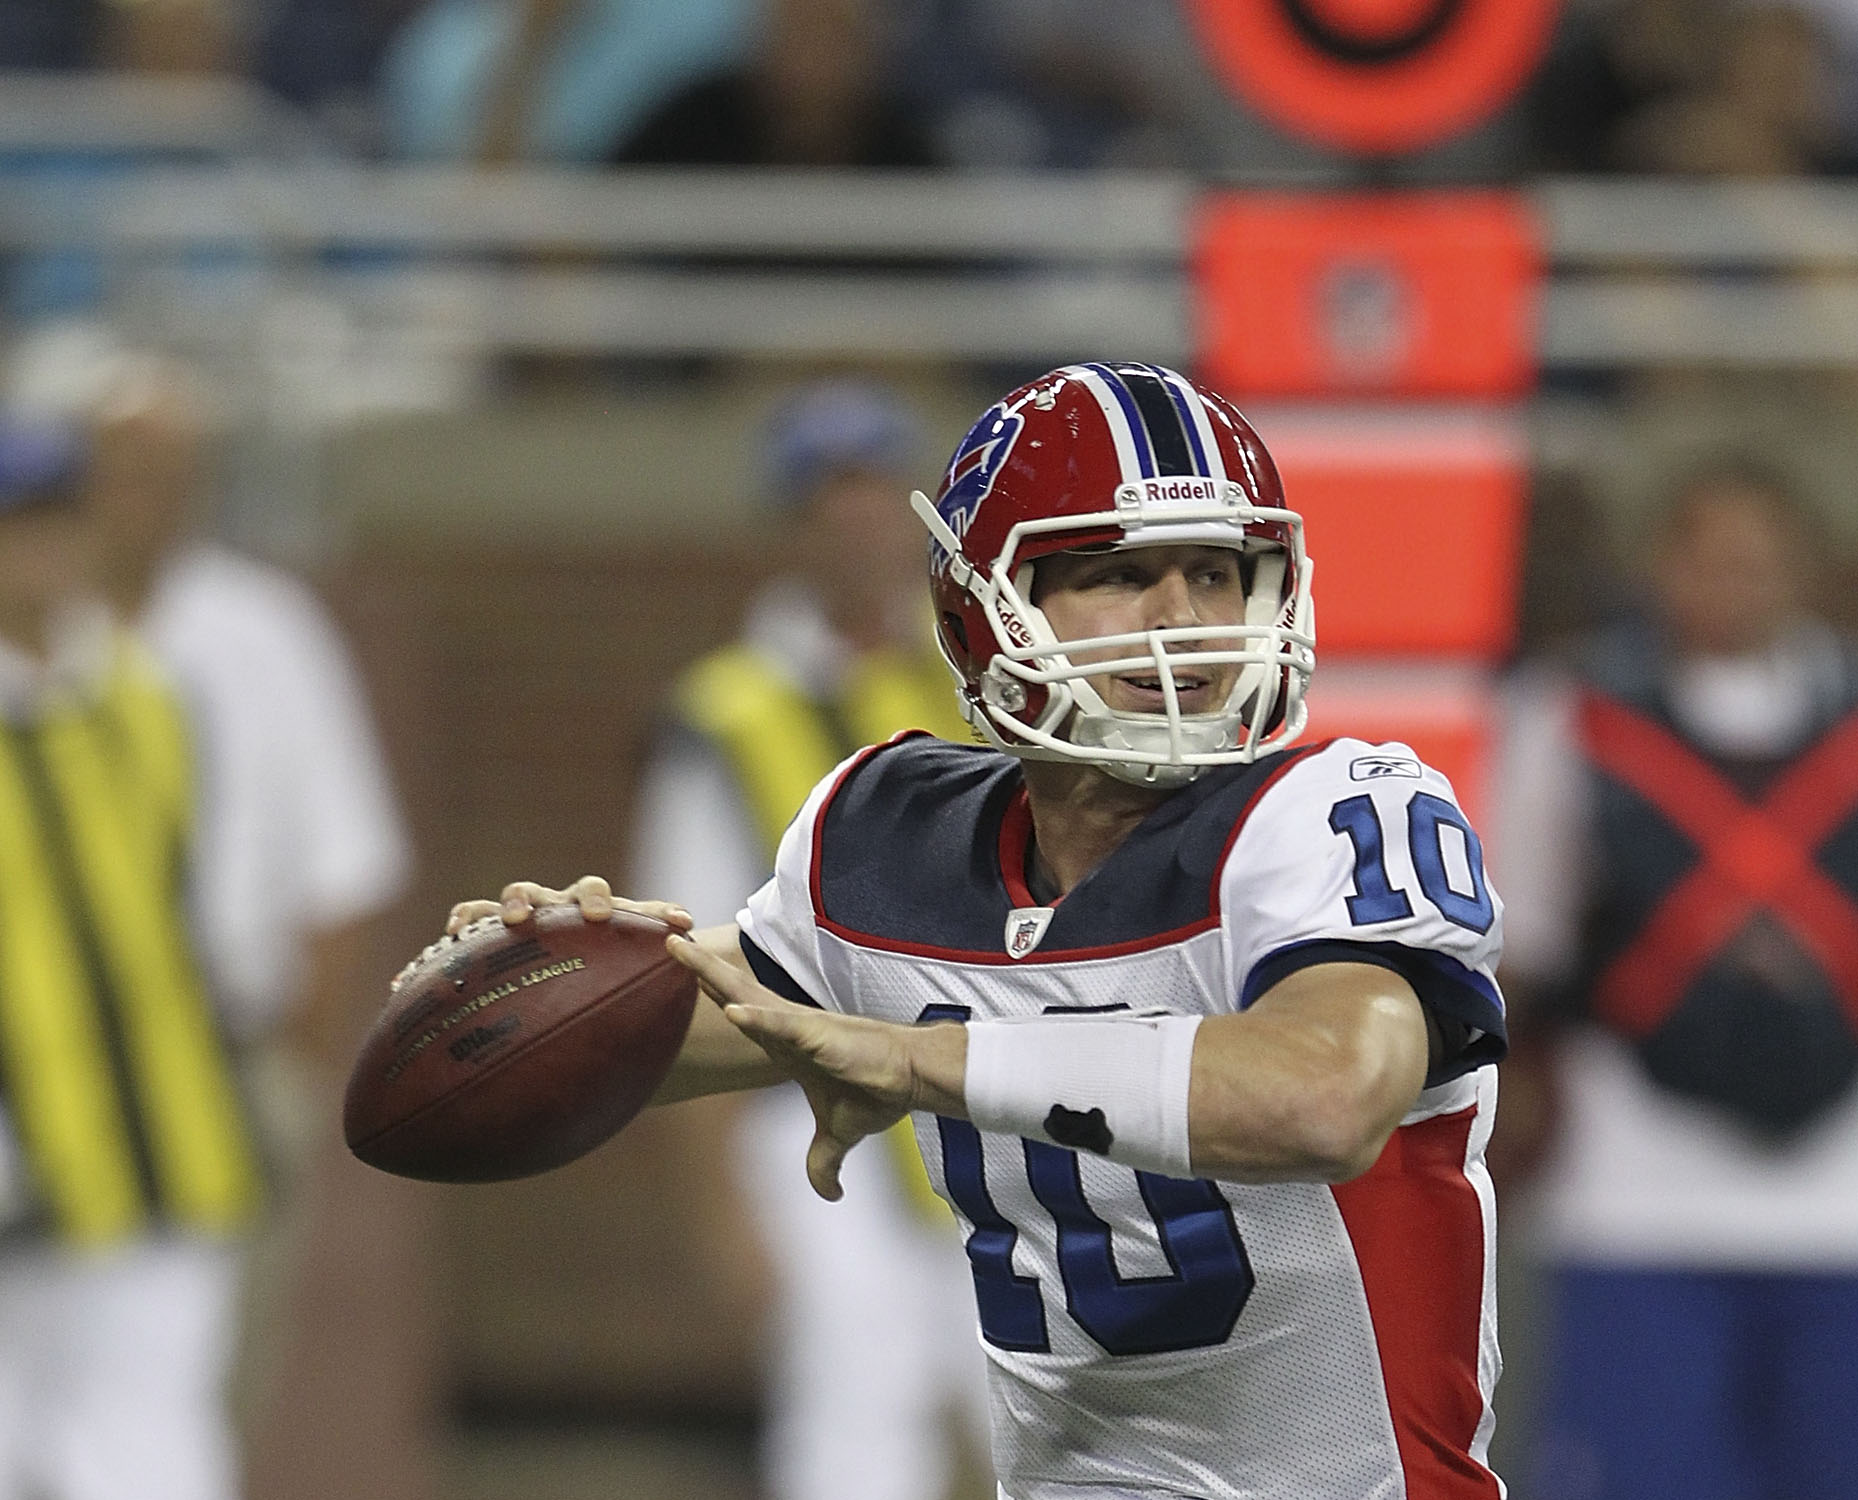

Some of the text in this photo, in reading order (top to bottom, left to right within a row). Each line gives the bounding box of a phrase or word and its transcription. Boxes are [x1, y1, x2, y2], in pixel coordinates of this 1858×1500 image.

[1145, 482, 1216, 501] Riddell
[1328, 790, 1495, 936] 10
[520, 958, 586, 987] LEAGUE
